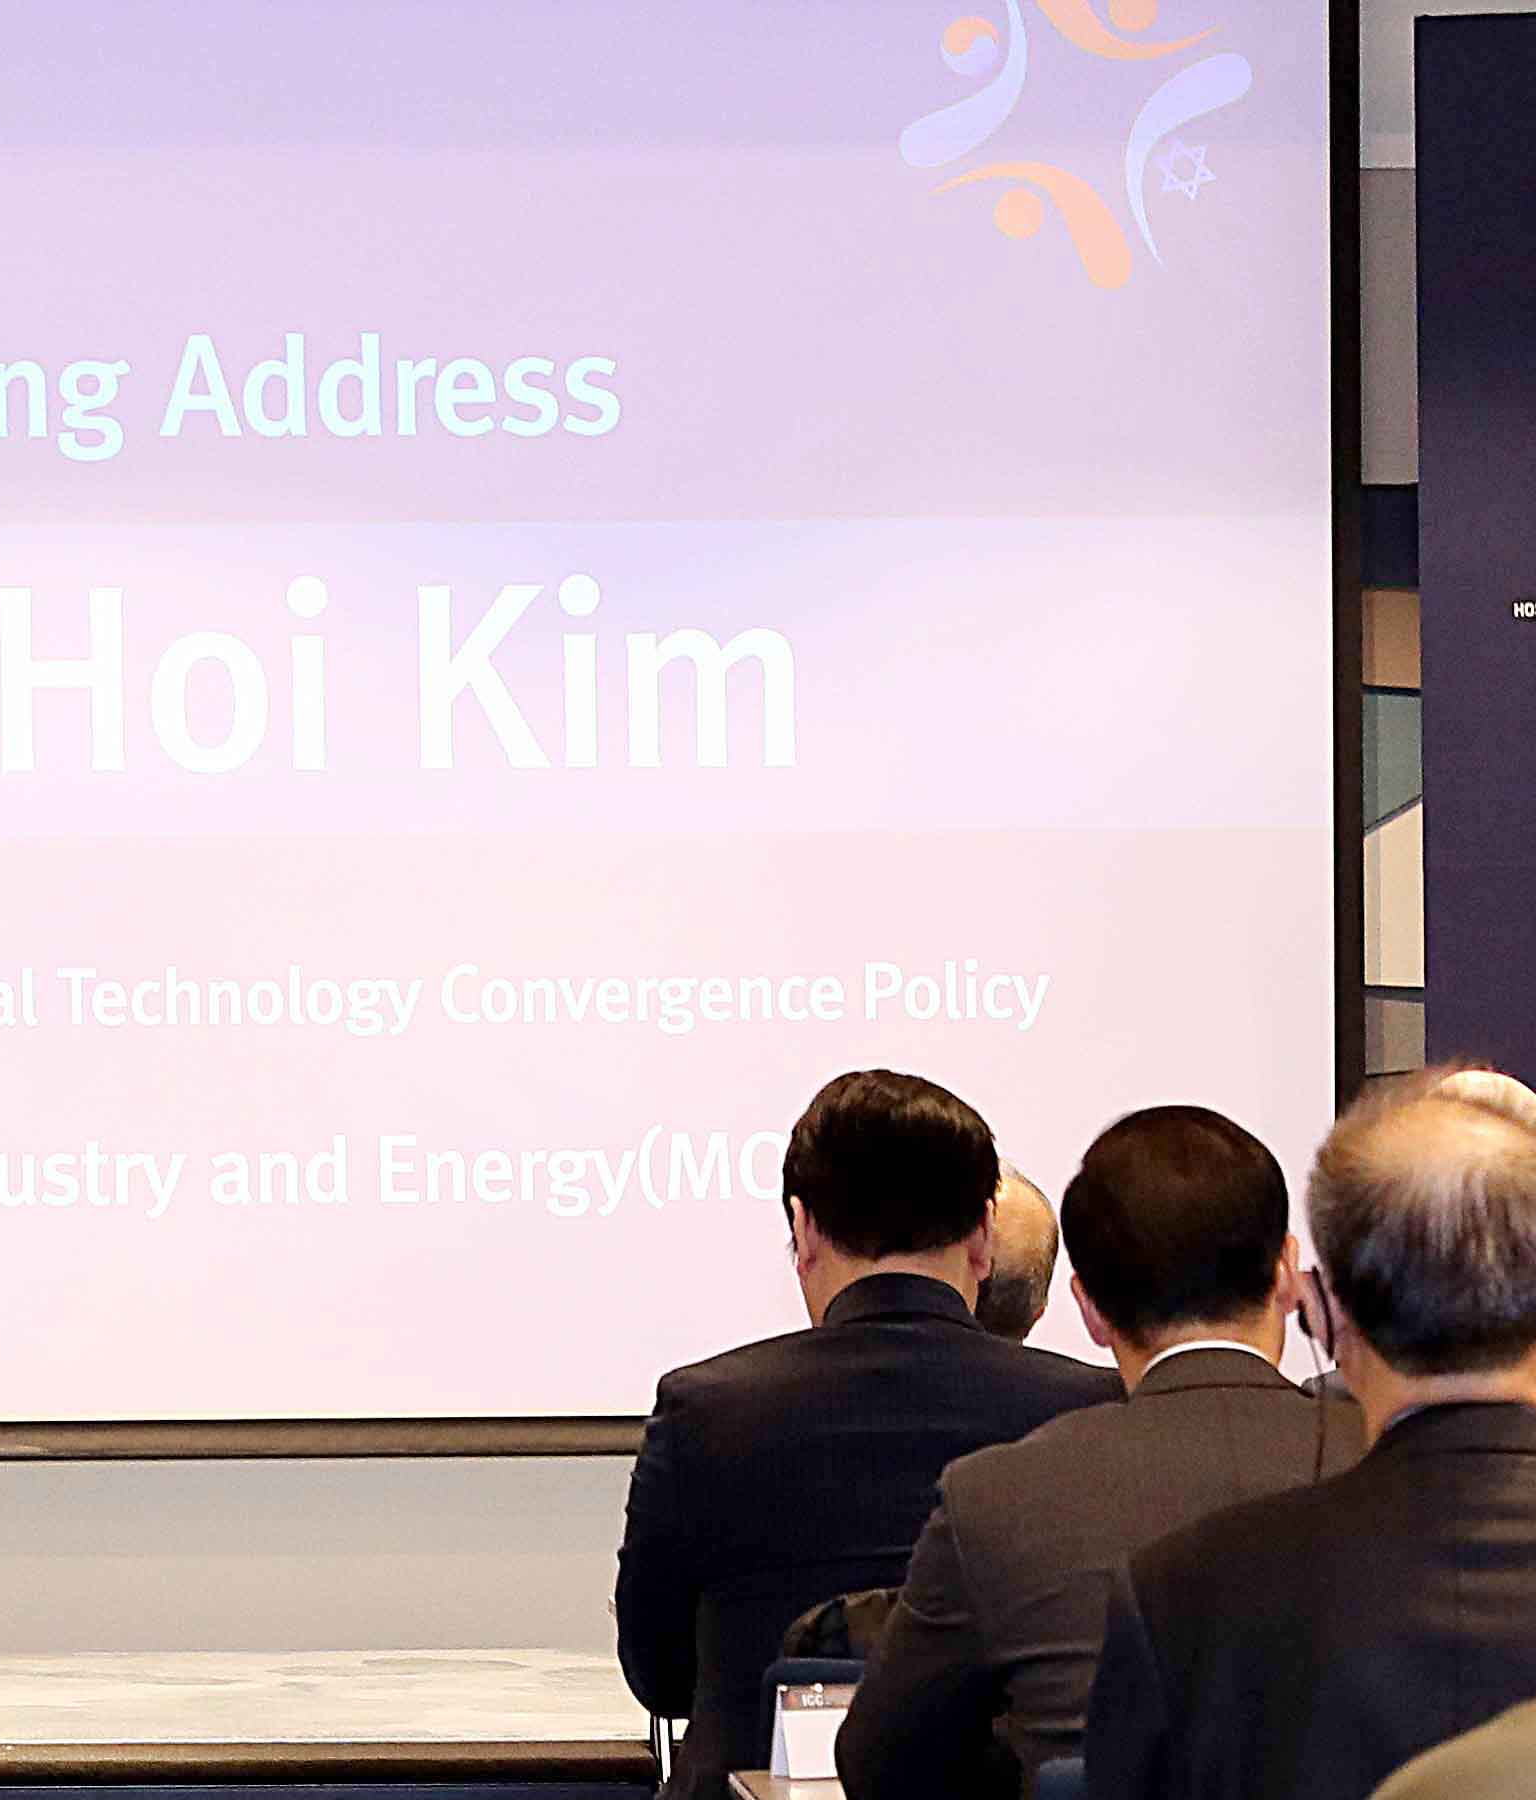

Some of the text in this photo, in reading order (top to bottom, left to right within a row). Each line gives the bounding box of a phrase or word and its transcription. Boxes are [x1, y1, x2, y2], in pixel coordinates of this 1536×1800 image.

[160, 332, 622, 437] Address
[418, 574, 796, 770] Kim
[57, 966, 421, 1036] Technology
[441, 964, 844, 1034] Convergence
[863, 960, 1049, 1028] Policy
[210, 1133, 348, 1204] and
[378, 1125, 785, 1215] Energy(MO
